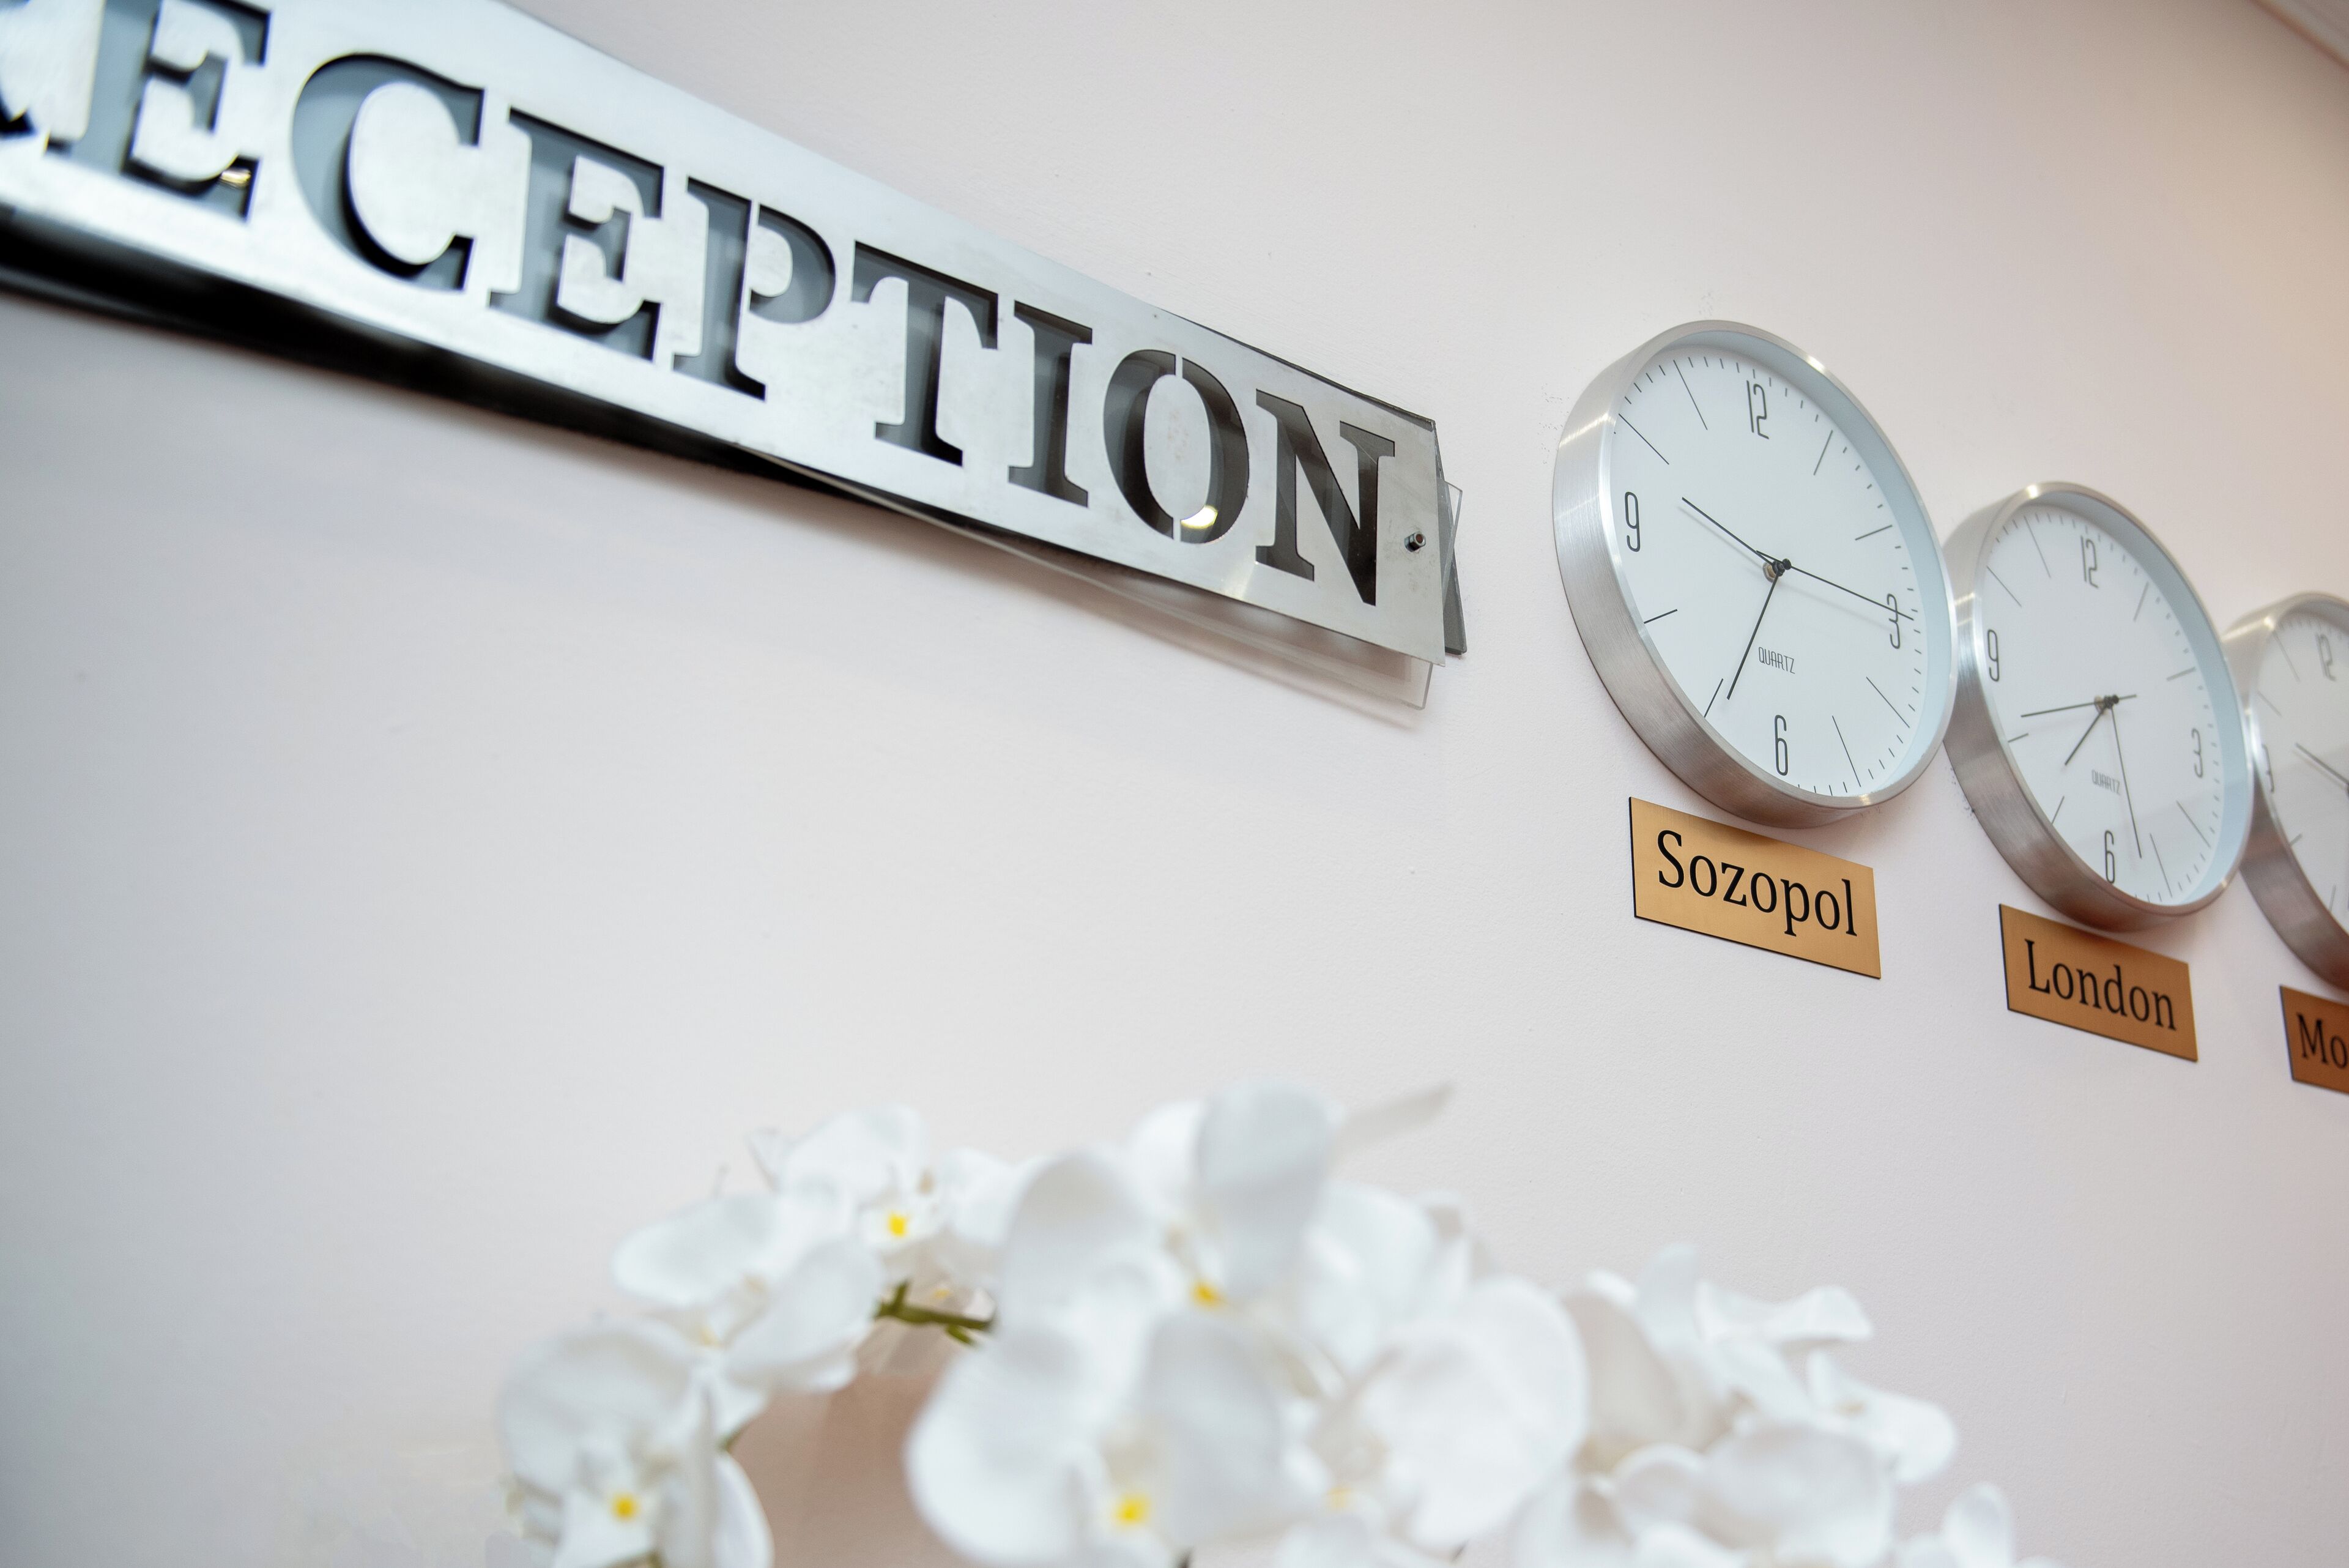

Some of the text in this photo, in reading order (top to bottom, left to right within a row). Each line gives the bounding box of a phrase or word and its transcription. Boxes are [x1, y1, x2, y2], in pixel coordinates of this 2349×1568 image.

[0, 0, 1395, 607] ECEPTION
[1746, 379, 1770, 440] 12
[1625, 491, 1641, 552] 9
[2080, 534, 2099, 589] 12
[1887, 593, 1901, 649] 3
[1757, 646, 1795, 675] QUARTZ
[1987, 629, 2000, 682] 9
[1774, 714, 1789, 776] 6
[2191, 728, 2203, 778] 3
[2091, 769, 2121, 795] QUARTZ
[1657, 830, 1857, 937] Sozopol
[2104, 830, 2116, 884] 6
[2025, 939, 2176, 1031] London
